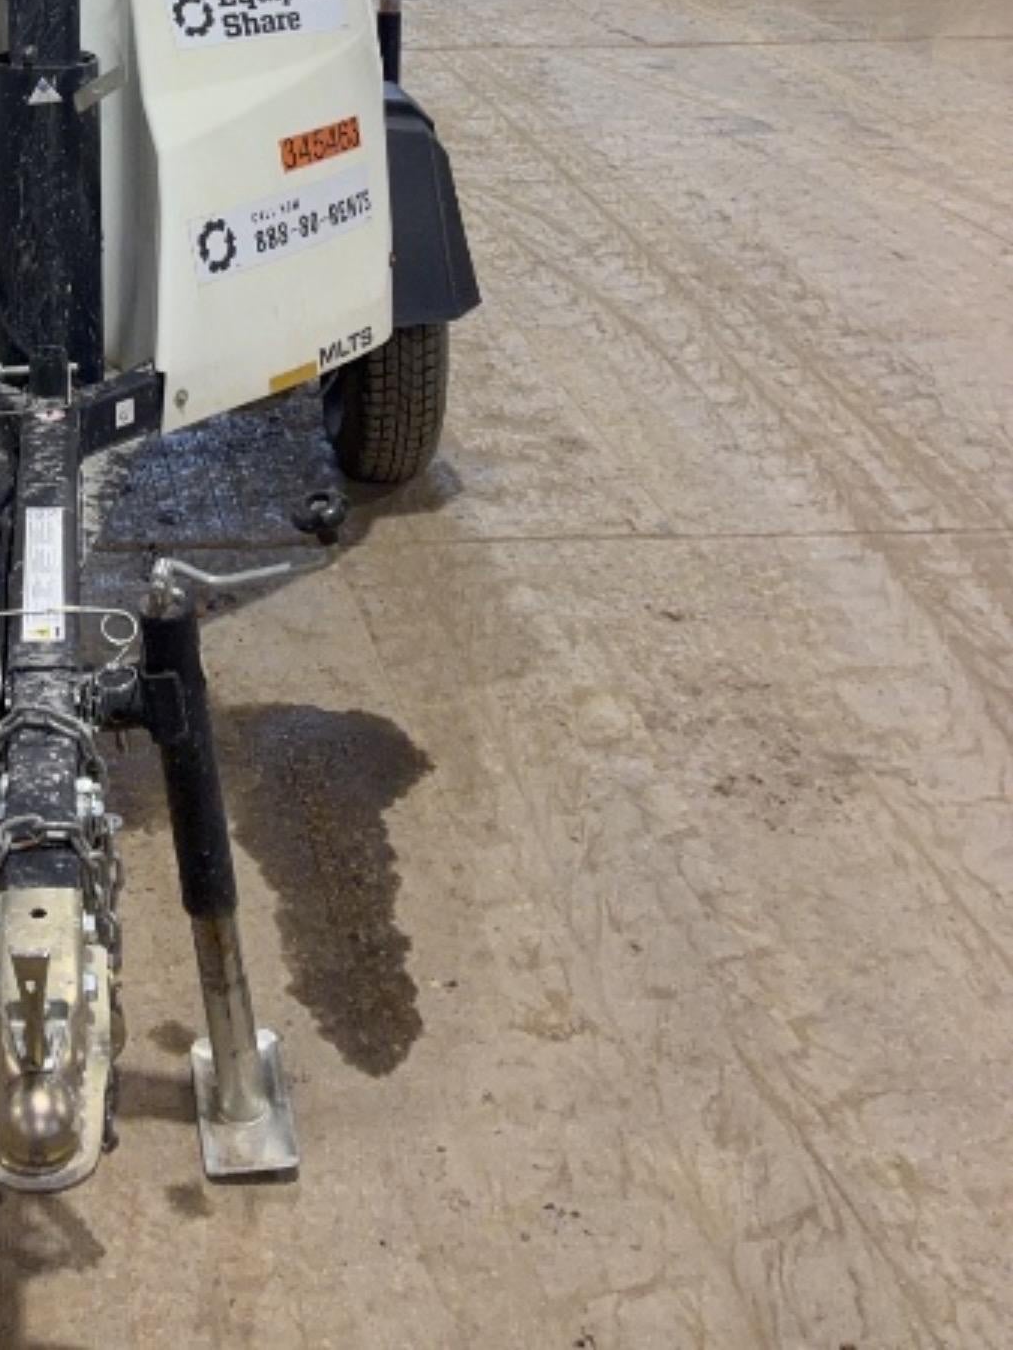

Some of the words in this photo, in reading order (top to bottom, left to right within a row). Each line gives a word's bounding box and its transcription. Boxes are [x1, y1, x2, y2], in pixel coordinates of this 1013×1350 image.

[222, 11, 301, 38] Share
[282, 116, 359, 169] 345463
[319, 326, 372, 369] MLTS
